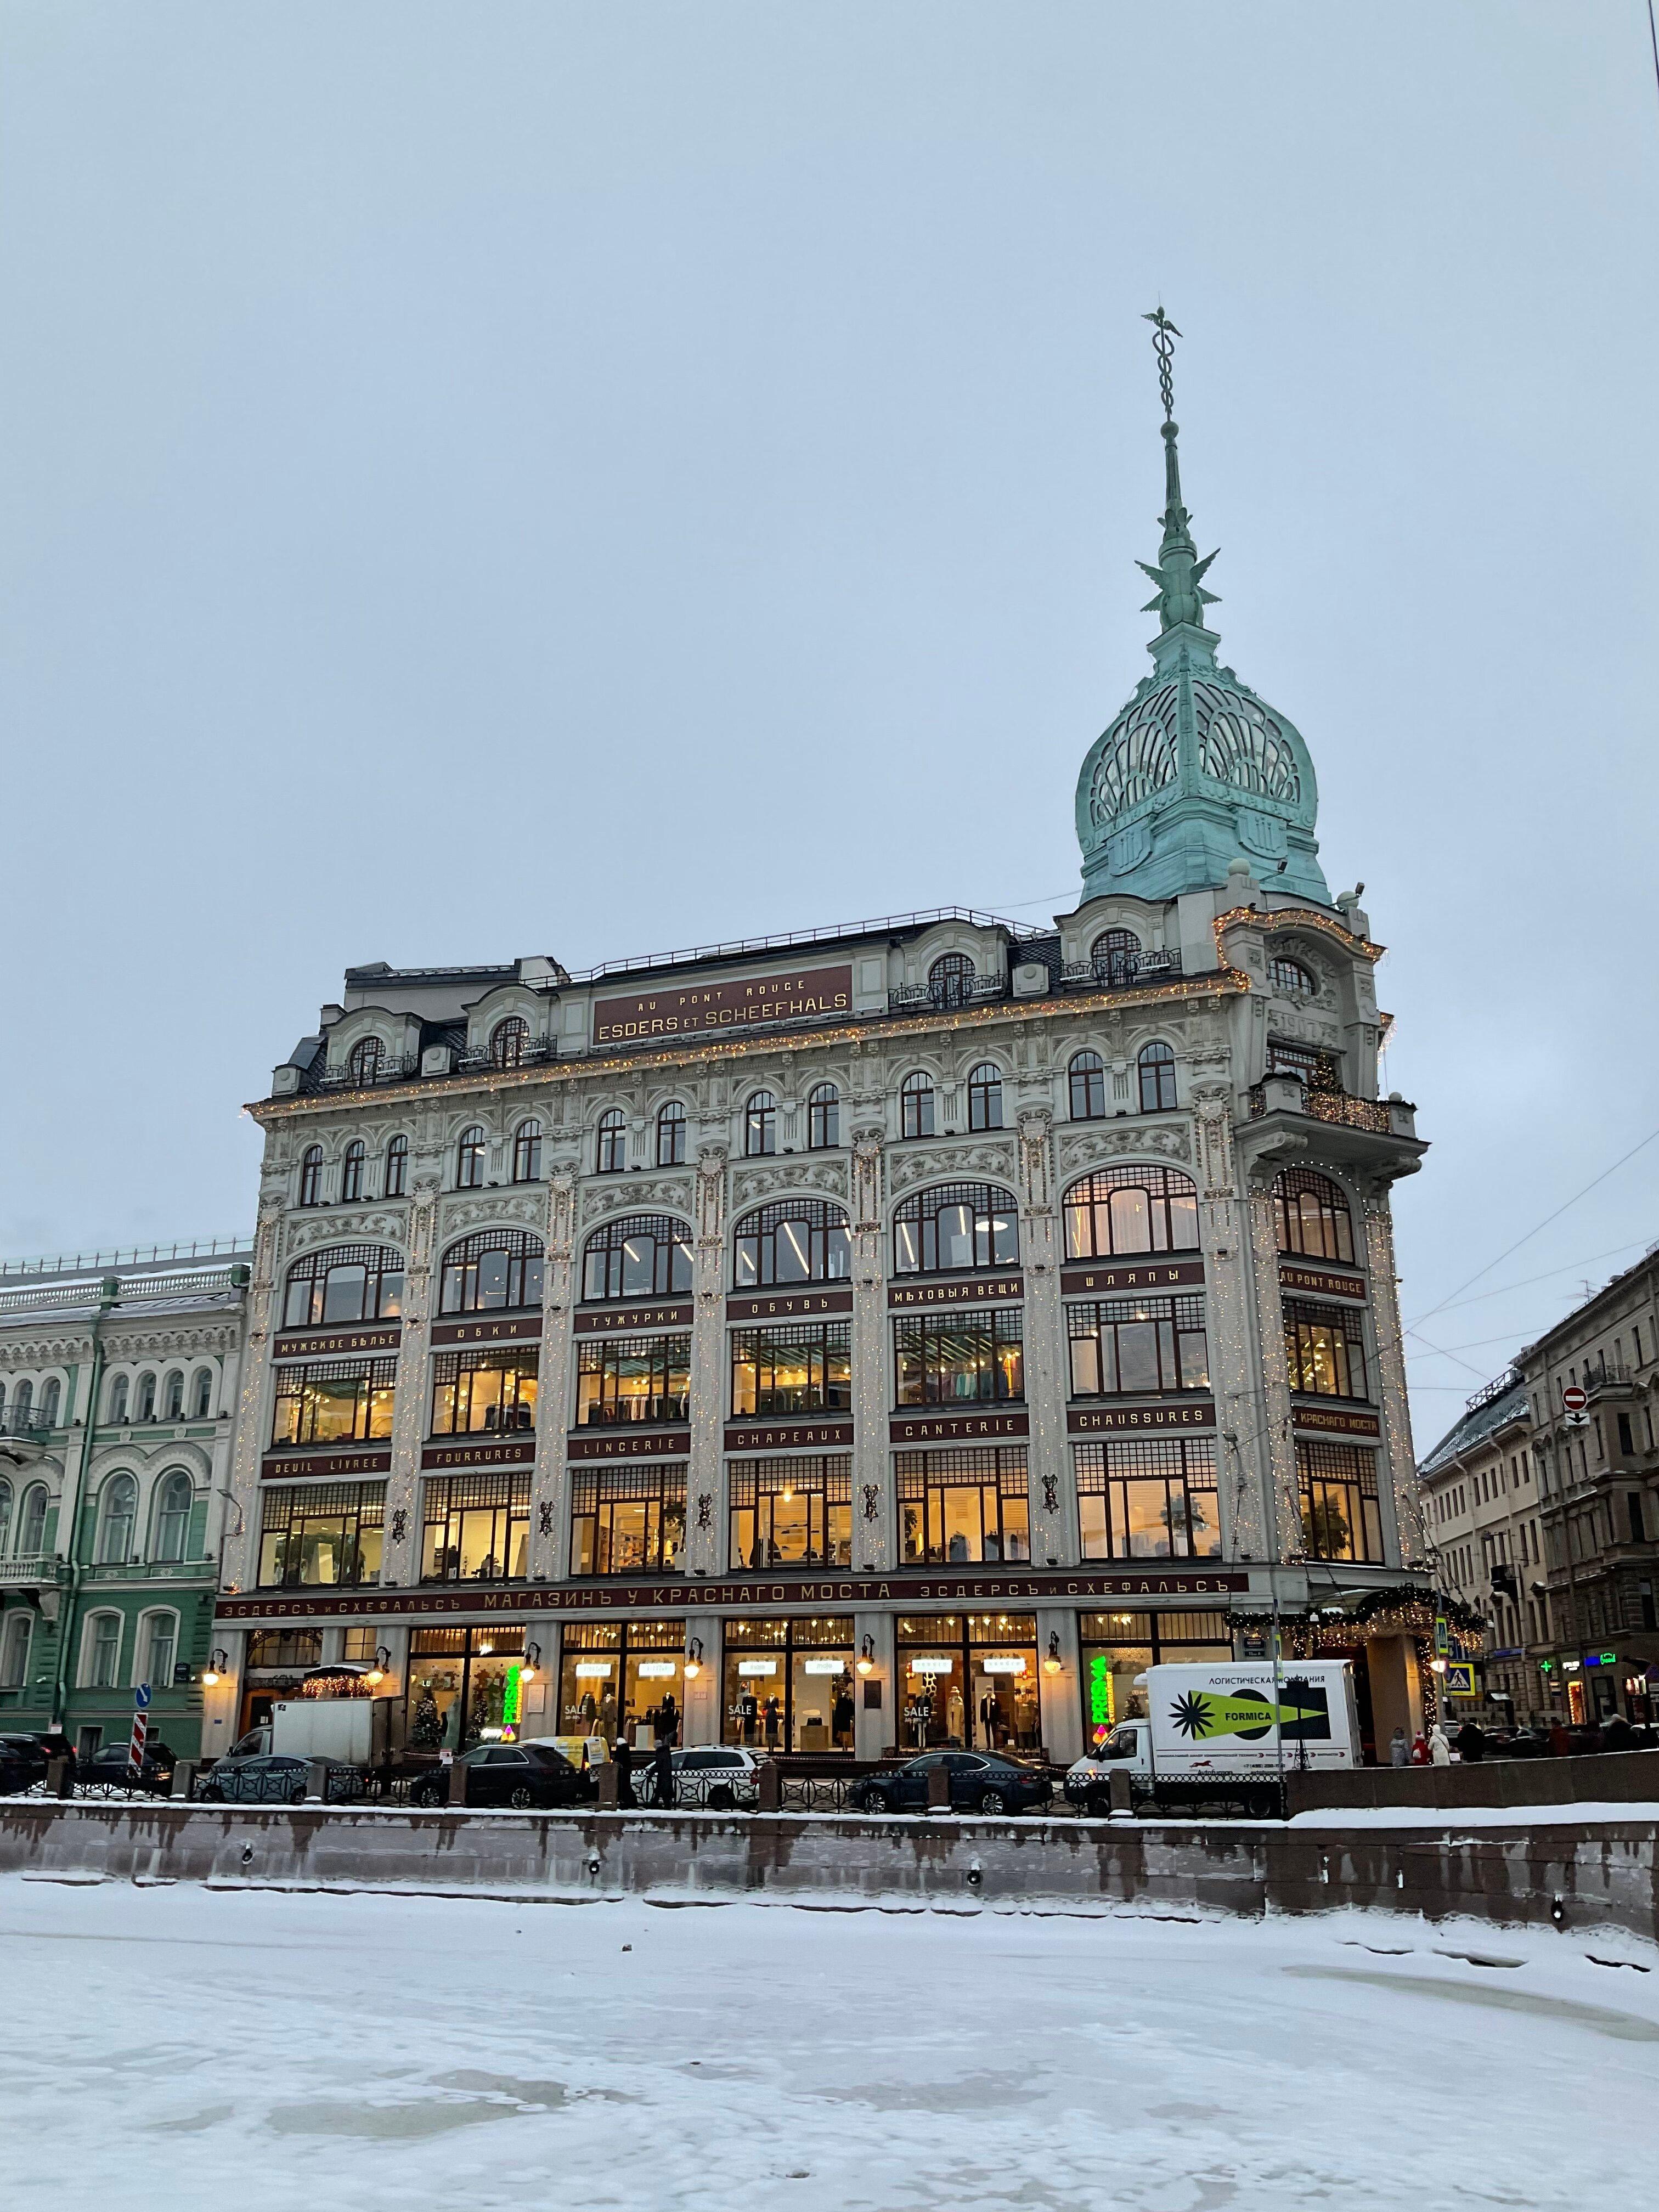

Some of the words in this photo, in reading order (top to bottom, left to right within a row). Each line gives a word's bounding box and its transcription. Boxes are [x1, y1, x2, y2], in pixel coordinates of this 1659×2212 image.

[638, 1002, 656, 1012] AU
[680, 992, 723, 1006] PONT
[747, 980, 805, 997] ROUGE
[599, 1017, 679, 1040] ESDERS
[684, 1017, 699, 1029] ET
[706, 993, 848, 1025] SCHEEFHALS
[1086, 1269, 1180, 1287] ШЛЯПЫ
[1281, 1271, 1293, 1282] AU
[1297, 1274, 1323, 1287] PONT
[1328, 1279, 1362, 1293] ROUGE
[978, 1283, 1017, 1295] ВЕЩИ
[752, 1299, 828, 1314] ОБУВЬ
[592, 1310, 678, 1327] ТУЖУРКИ
[458, 1325, 518, 1339] ЮБКИ
[281, 1339, 344, 1353] МУЖСКОЕ
[1079, 1409, 1203, 1427] CHAUSSURES
[1301, 1413, 1345, 1427] КРАСНАГО
[1350, 1419, 1378, 1431] МОСТА
[738, 1429, 842, 1446] CHAPEAUX
[437, 1448, 522, 1464] FOURRURES
[275, 1460, 312, 1474] DEUIL
[330, 1458, 378, 1470] LIVREE
[225, 1604, 315, 1616] ЭСДЕРСЪ
[338, 1600, 460, 1613] СХЕФАЛЬСЪ
[484, 1590, 612, 1609] МАГАЗИНЪ
[628, 1590, 638, 1605] У
[653, 1585, 786, 1603] КРАСНАГО
[802, 1583, 891, 1600] МОСТА
[921, 1584, 1039, 1597] ЭСДЕРСЪ
[1067, 1580, 1228, 1595] СХЕФАЛЬСЪ
[503, 1664, 521, 1723] PRISMA
[1091, 1656, 1109, 1724] PRISMA
[565, 1705, 587, 1714] SALE
[728, 1705, 752, 1714] SALE
[904, 1707, 929, 1717] SALE
[1225, 1712, 1272, 1721] FORMICA
